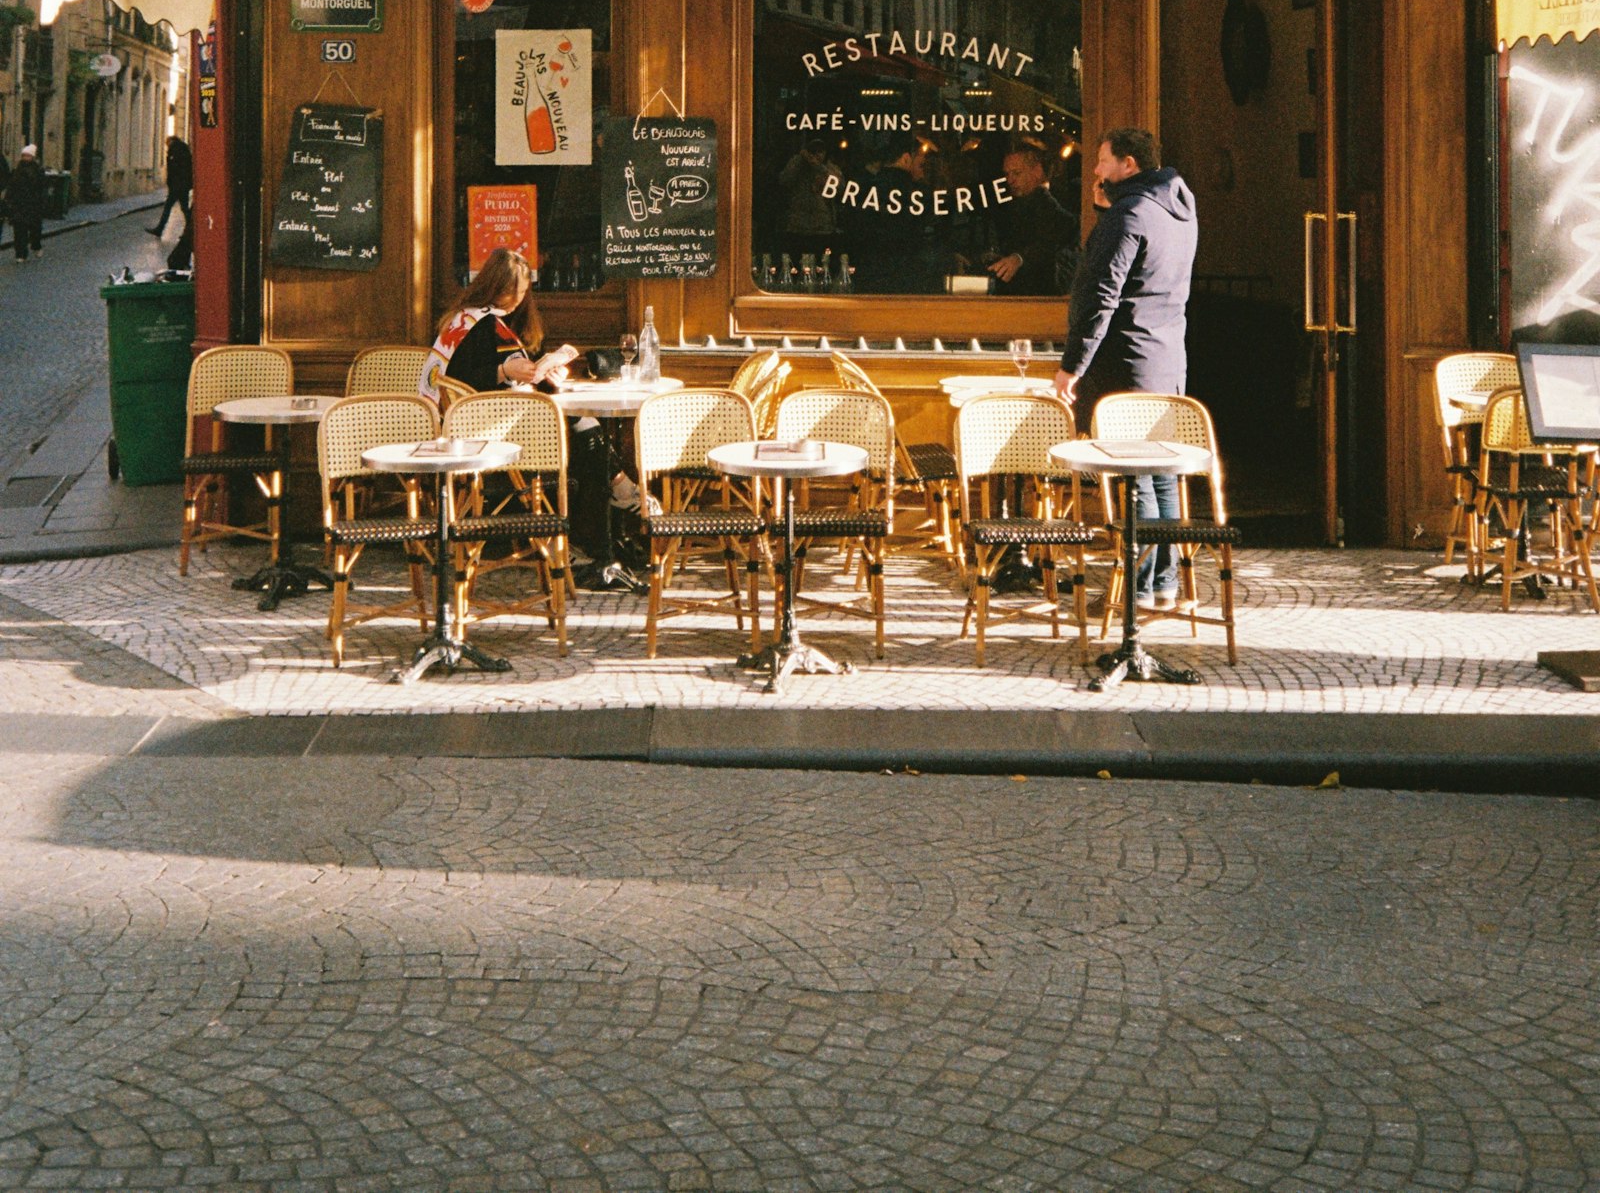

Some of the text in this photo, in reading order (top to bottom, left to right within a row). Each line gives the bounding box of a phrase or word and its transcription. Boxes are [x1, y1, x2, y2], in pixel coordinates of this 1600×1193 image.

[324, 42, 353, 61] 50
[801, 29, 1034, 78] RESTAURANT
[511, 48, 548, 107] BEAUJOLAIS
[546, 90, 570, 151] NOUVEAU
[633, 126, 706, 141] LE BEAUJOLAIS
[660, 143, 701, 156] NOUVEAU
[665, 158, 680, 168] EST
[324, 170, 345, 184] Plat
[290, 190, 311, 203] Plat
[821, 177, 1014, 216] BRASSERIE
[484, 199, 520, 210] PUDLO
[484, 214, 521, 223] BISTROTS
[314, 233, 331, 244] Plat
[617, 225, 641, 240] TOUS
[643, 227, 660, 239] LES
[606, 242, 633, 255] GRILLE
[682, 253, 693, 262] 20
[641, 265, 662, 276] POUR
